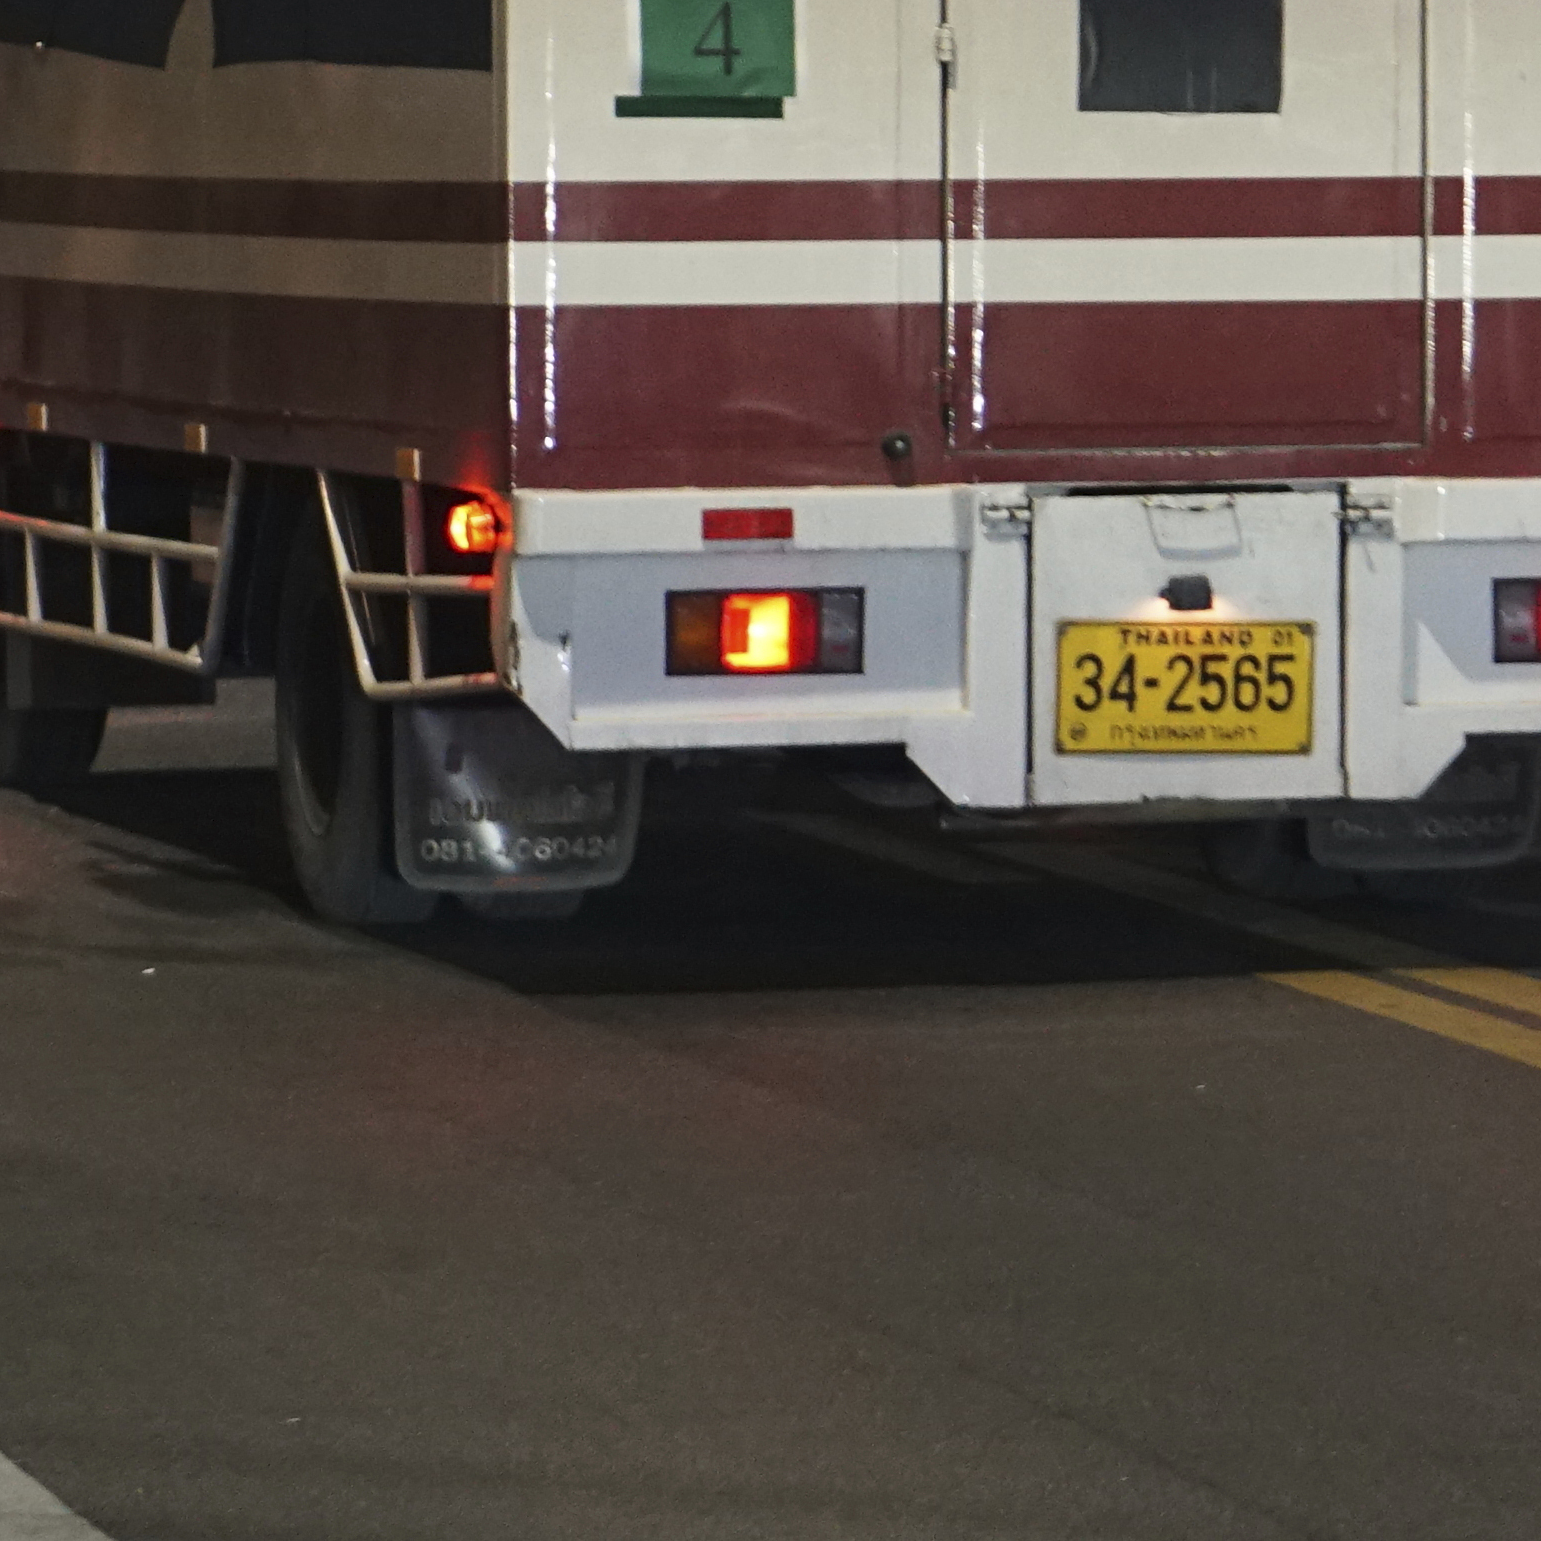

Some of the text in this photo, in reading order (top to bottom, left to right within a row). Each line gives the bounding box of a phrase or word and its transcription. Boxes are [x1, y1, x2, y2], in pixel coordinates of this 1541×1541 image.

[694, 1, 741, 76] 4
[1121, 628, 1253, 647] THAILAND
[1074, 654, 1296, 713] 34-2565
